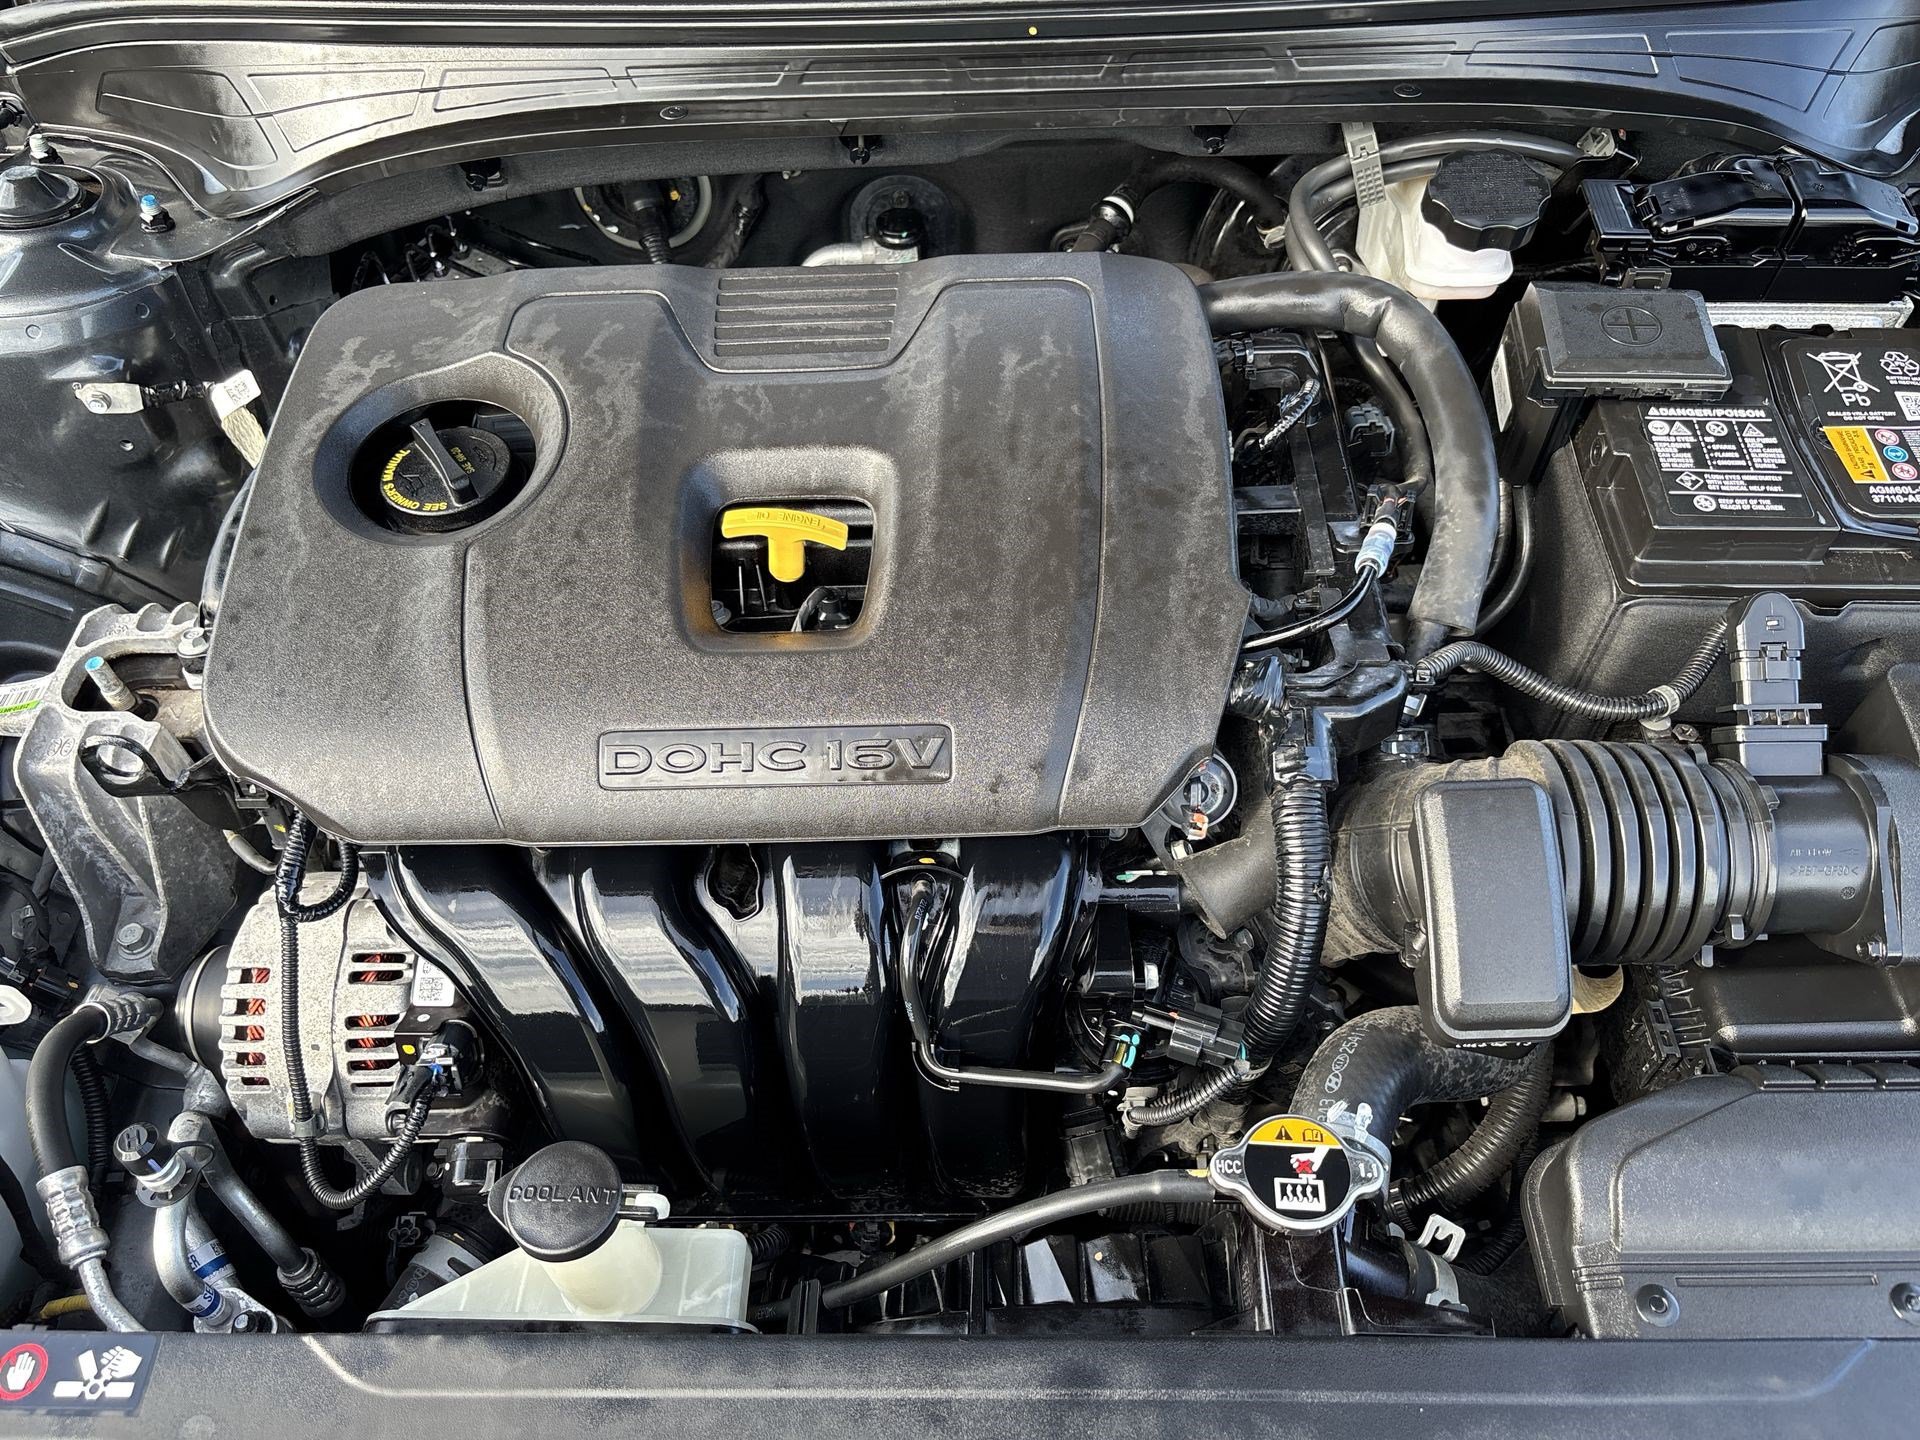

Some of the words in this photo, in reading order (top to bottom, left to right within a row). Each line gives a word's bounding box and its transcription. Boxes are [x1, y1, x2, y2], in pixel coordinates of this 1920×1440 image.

[1841, 393, 1871, 407] Pb
[1658, 407, 1766, 418] DANGER/POISON
[382, 448, 411, 482] MANUAL
[462, 461, 476, 474] SAE
[382, 484, 420, 510] OWNER'S
[1869, 485, 1920, 494] AGM60L-
[422, 502, 448, 511] SEE
[776, 511, 821, 529] ENGINE
[604, 740, 807, 776] DOHC
[826, 736, 946, 771] 16V
[1215, 1158, 1243, 1175] HCC
[1358, 1162, 1379, 1178] 1.1
[508, 1185, 618, 1205] COOLANT
